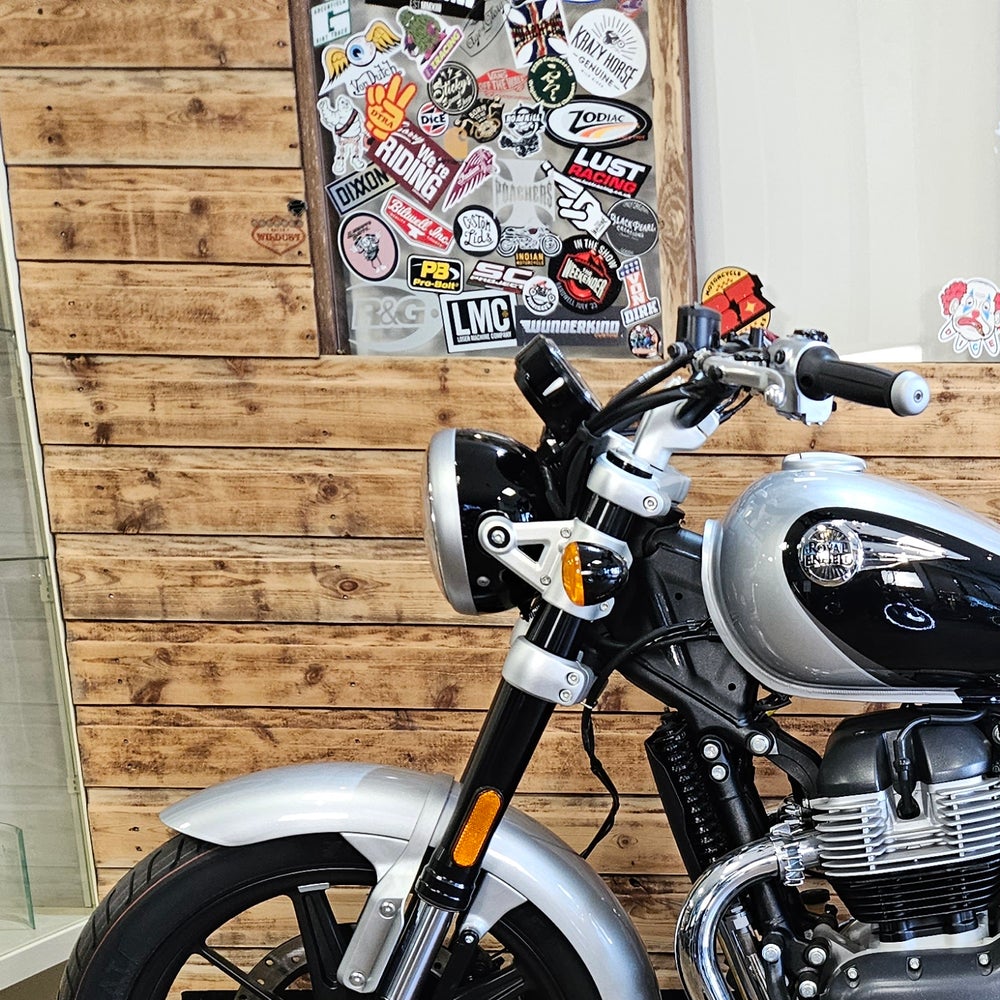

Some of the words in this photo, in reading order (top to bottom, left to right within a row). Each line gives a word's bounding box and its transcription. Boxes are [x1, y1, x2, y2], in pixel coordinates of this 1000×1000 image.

[571, 25, 607, 61] KRAZY
[605, 52, 639, 90] HORSE
[577, 56, 613, 87] GENUINE
[371, 110, 394, 128] DTRA
[374, 135, 443, 200] RIDING
[417, 143, 450, 179] We're
[574, 147, 645, 181] LUST
[336, 167, 390, 206] DIXXON
[568, 163, 637, 195] RACING
[420, 260, 450, 281] PB
[573, 239, 582, 250] IN
[598, 244, 619, 270] SHOW
[561, 257, 608, 299] WEEKENDER
[705, 270, 742, 297] MOTORCYCLE
[452, 298, 510, 339] LMC
[519, 320, 620, 334] WUNDERKIND
[624, 302, 659, 325] DIRK
